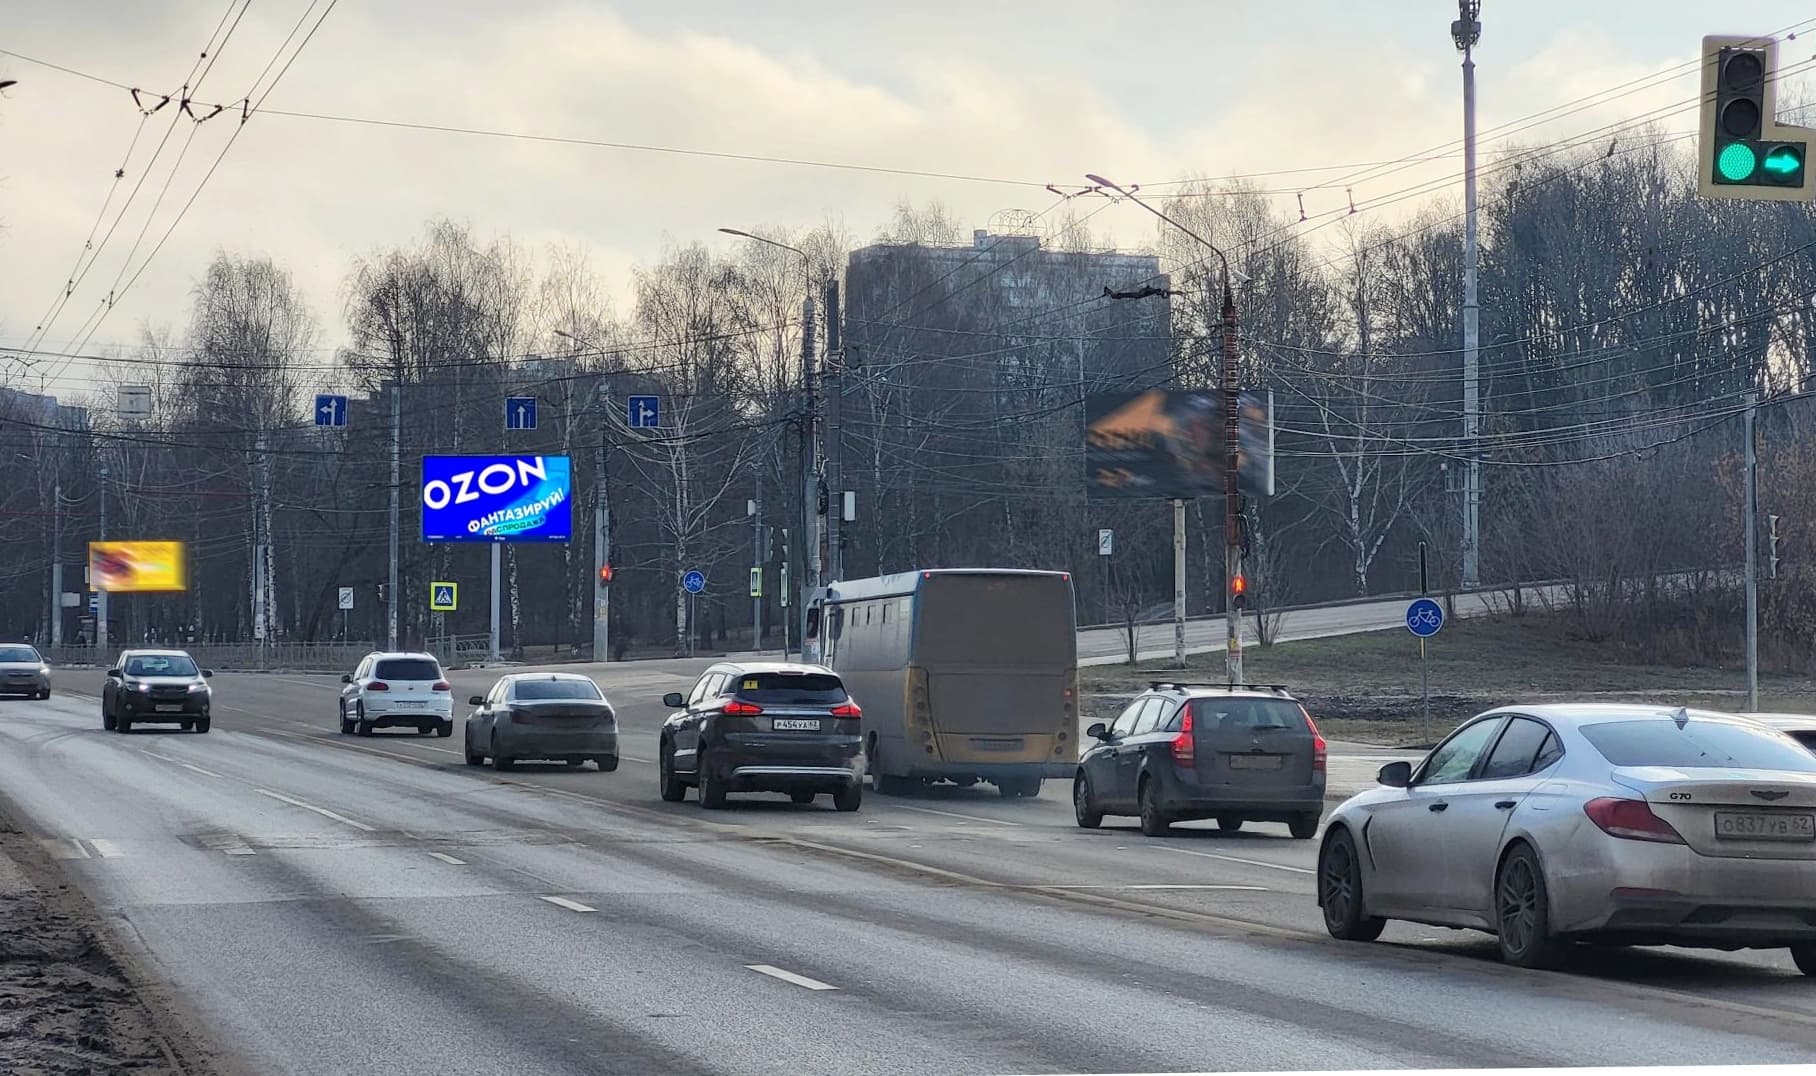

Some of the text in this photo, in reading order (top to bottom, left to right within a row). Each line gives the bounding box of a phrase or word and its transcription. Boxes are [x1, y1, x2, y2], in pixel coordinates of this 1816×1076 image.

[424, 456, 547, 510] OZON
[467, 488, 565, 533] ФАНТАЗИРУЙ!
[1669, 792, 1692, 800] G70
